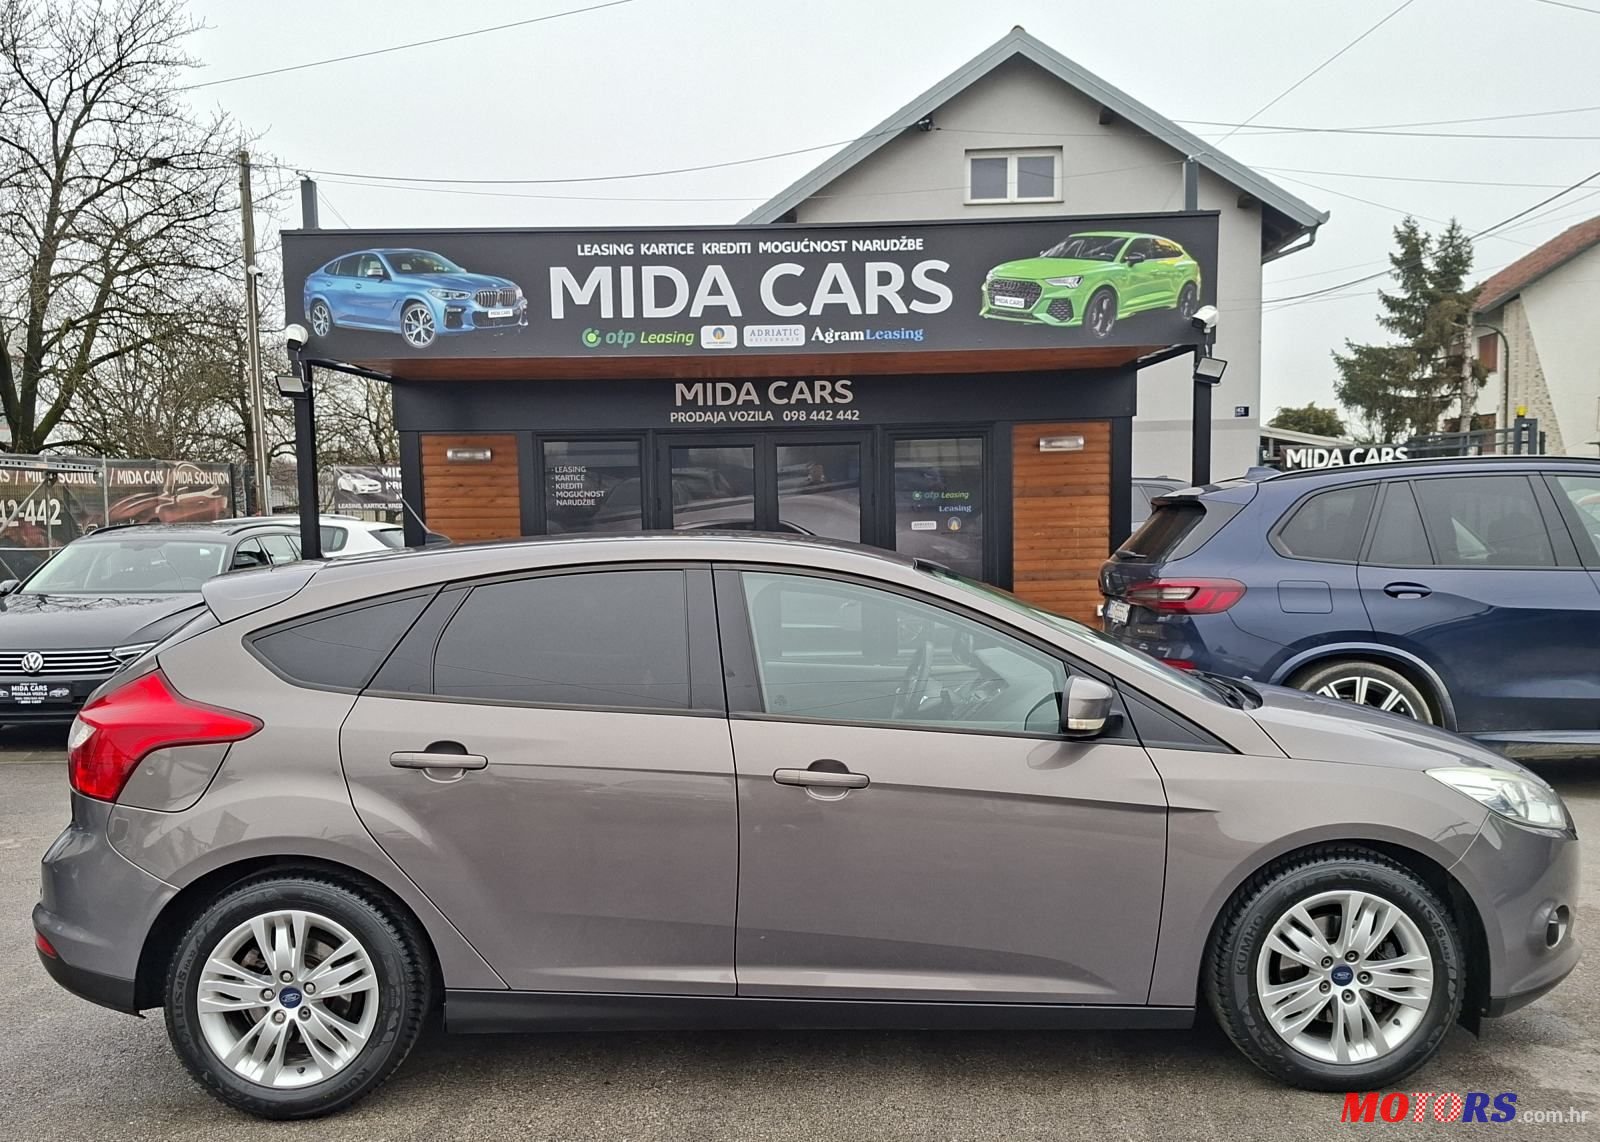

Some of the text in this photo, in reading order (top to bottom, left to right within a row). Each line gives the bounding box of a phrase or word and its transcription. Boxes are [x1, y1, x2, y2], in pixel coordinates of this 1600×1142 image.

[577, 235, 924, 257] LEASING KARTICE KREDITI MOGUĆNOST NARUDŽBE
[549, 259, 954, 320] MIDA CARS
[605, 328, 695, 348] otp Leasing
[749, 328, 801, 337] ADRIATIC
[675, 379, 854, 407] MIDA CARS
[670, 409, 860, 424] PRODAJA VOZILA 098 442 442
[1285, 446, 1409, 468] MIDA CARS
[117, 470, 143, 485] MIDA
[143, 470, 165, 485] CARS
[173, 470, 193, 485] MIDA
[194, 471, 229, 485] SOLUTION
[554, 465, 587, 473] LEASING
[941, 491, 970, 500] Leasing
[939, 504, 971, 512] Leasing
[1236, 913, 1264, 976] KUMHO
